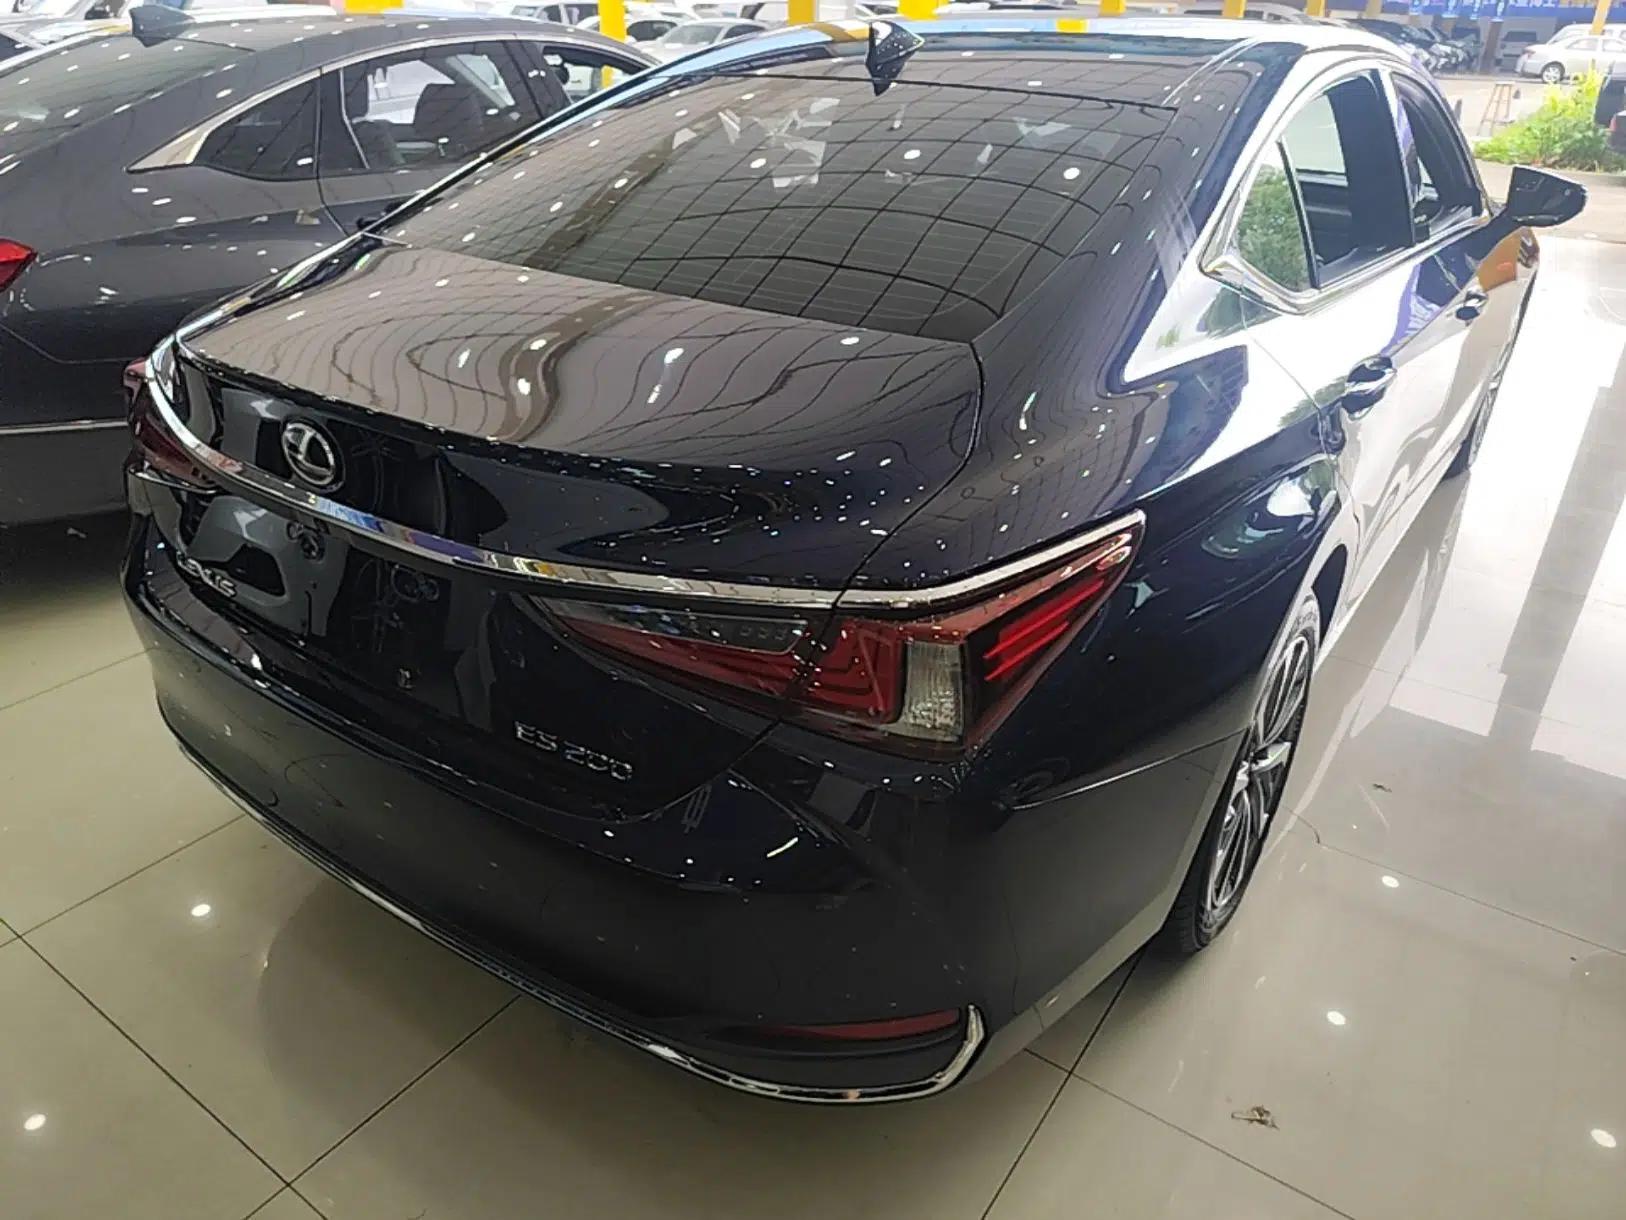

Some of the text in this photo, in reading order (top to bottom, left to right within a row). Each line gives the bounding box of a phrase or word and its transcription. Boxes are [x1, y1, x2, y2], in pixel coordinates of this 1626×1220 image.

[176, 551, 236, 598] LEXUS
[514, 721, 633, 781] ES 200
